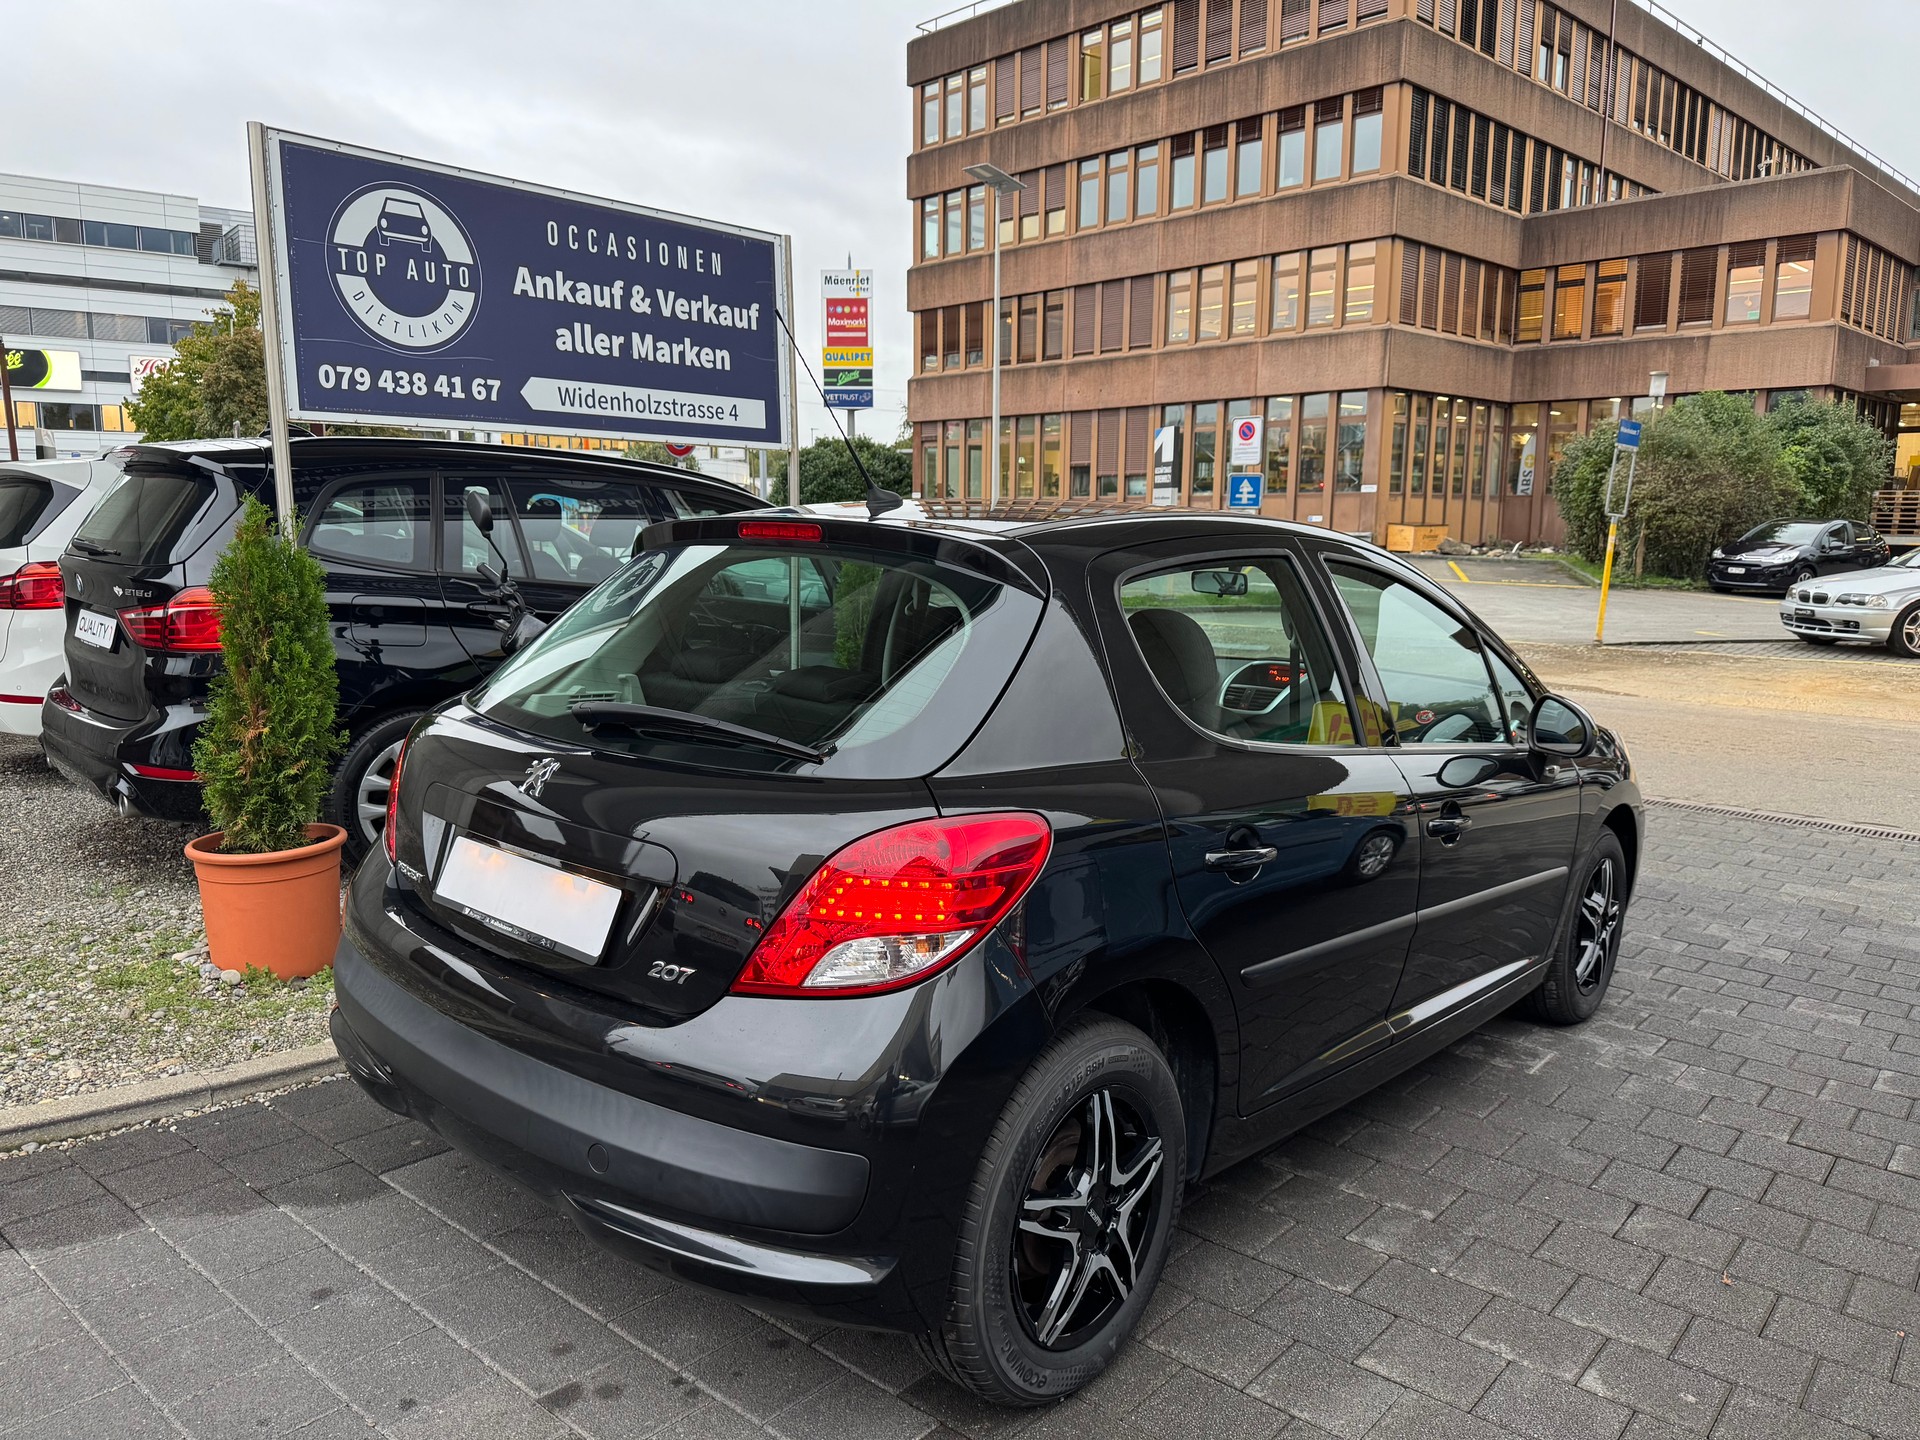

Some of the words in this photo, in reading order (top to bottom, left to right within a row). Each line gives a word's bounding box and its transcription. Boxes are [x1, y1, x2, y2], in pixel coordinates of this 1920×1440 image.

[547, 221, 722, 276] OCCASIONEN
[338, 248, 387, 275] TOP
[407, 259, 470, 288] AUTO
[353, 291, 464, 338] DIETLIKON
[513, 266, 625, 310] Ankauf
[630, 285, 652, 314] &
[656, 288, 760, 330] Verkauf
[828, 317, 866, 327] Maximarkt
[555, 322, 625, 357] aller
[632, 331, 731, 371] Marken
[825, 352, 871, 361] QUALIPET
[318, 364, 371, 391] 079
[378, 370, 428, 395] 438
[434, 375, 465, 400] 41
[471, 378, 501, 401] 67
[557, 386, 725, 420] Widenholzstrasse
[729, 404, 739, 421] 4
[647, 960, 697, 985] 207
